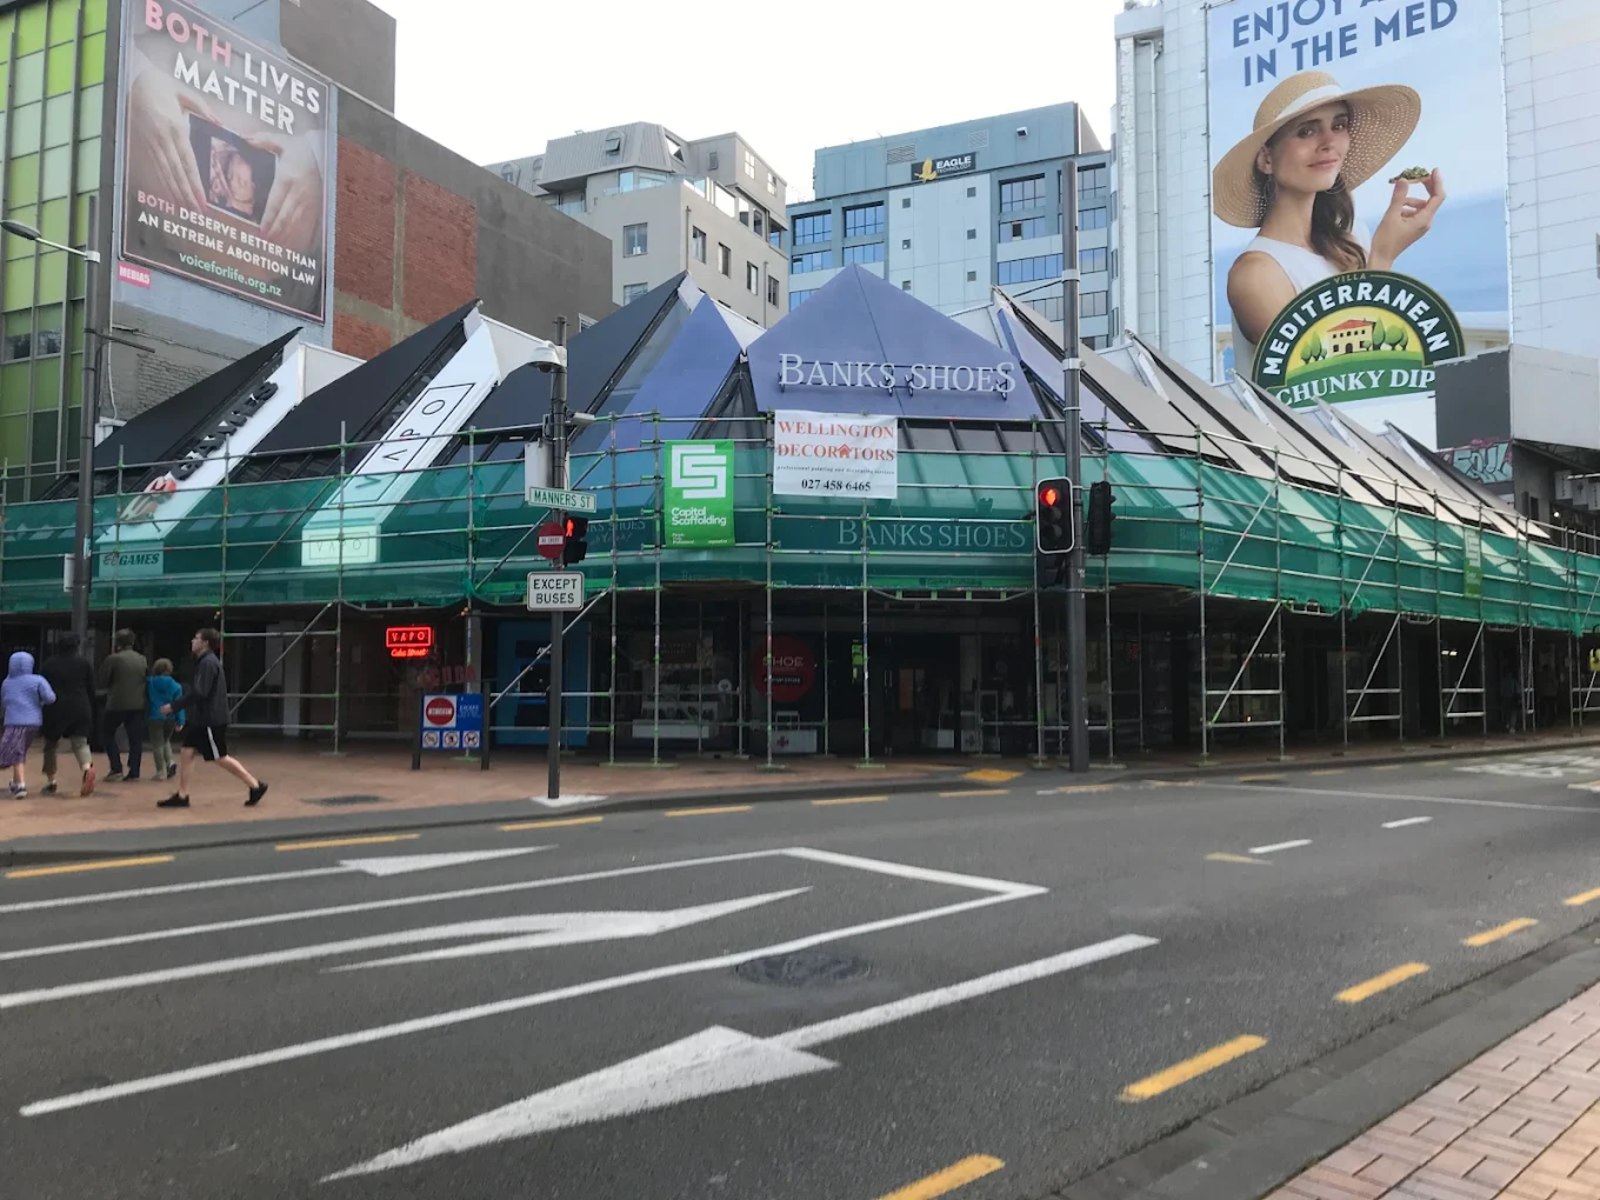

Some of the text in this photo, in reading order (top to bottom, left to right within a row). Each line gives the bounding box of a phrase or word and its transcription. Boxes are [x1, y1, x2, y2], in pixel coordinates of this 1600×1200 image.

[145, 1, 320, 114] BOTH LIVES
[1244, 0, 1458, 86] IN THE MED
[174, 52, 294, 134] MATTER
[936, 155, 971, 169] EAGLE
[137, 190, 316, 270] BOTH DESERVE BETTER THAN
[137, 211, 315, 286] AN EXTREME ABORTION LAW
[179, 252, 282, 297] voiceforlife.org.nz
[1263, 282, 1450, 375] MEDITERRANEAN
[779, 353, 1016, 393] BANKS SHOES
[1275, 369, 1383, 406] CHUNKY
[778, 421, 895, 438] WELLINGTON
[534, 490, 591, 508] MANNERS ST
[801, 479, 872, 491] 027 458 6465
[671, 505, 707, 518] Capital
[671, 514, 727, 527] Scaffolding
[837, 519, 1026, 548] BANKS SHOES
[119, 553, 160, 567] GAMES
[533, 578, 578, 590] EXCEPT
[535, 593, 575, 604] BUSES
